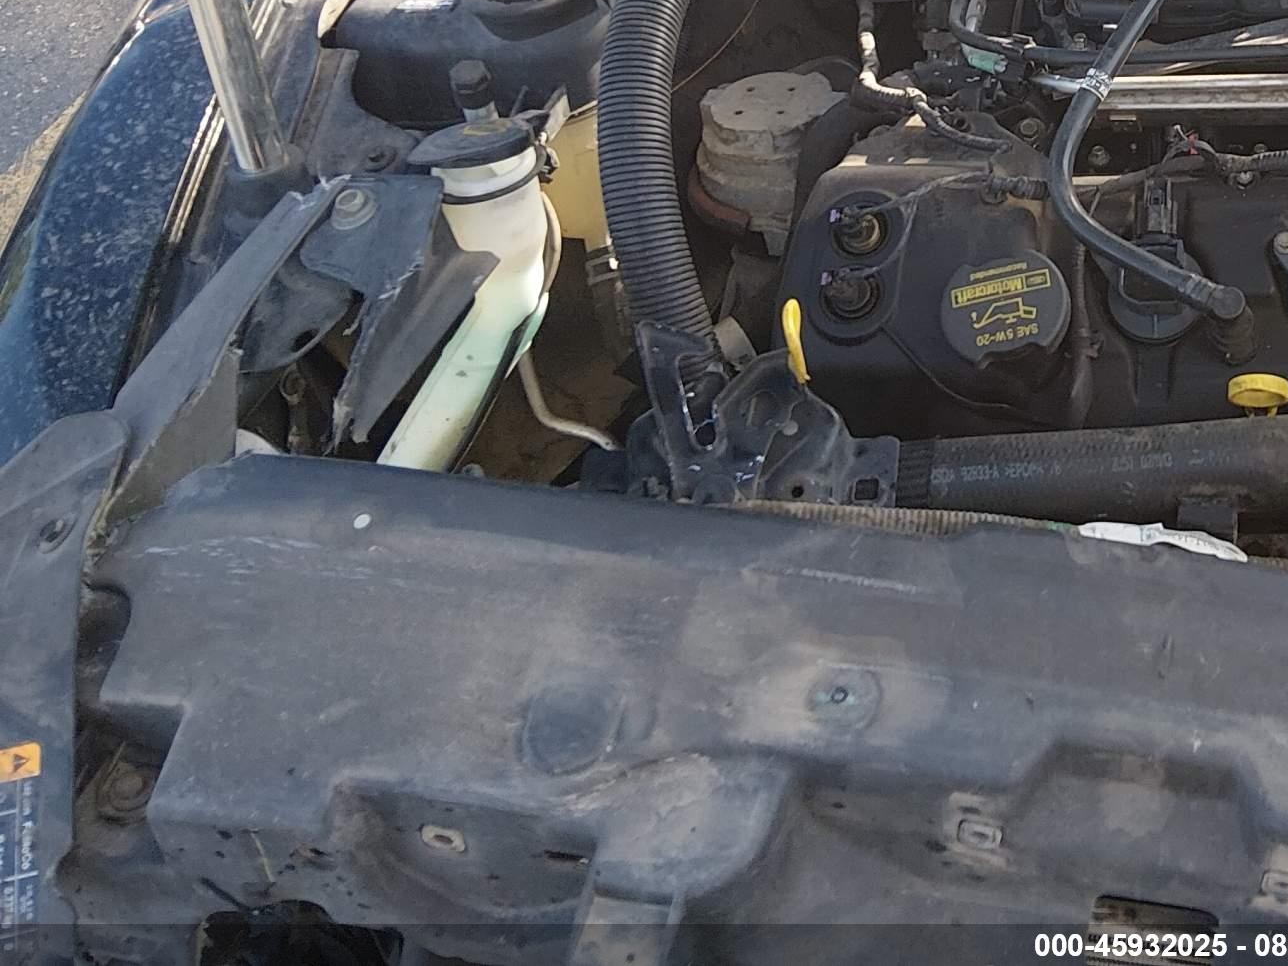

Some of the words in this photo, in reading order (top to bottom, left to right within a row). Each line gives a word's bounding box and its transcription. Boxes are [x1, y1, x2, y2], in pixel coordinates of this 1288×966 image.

[957, 277, 1022, 303] Motorcraft
[976, 328, 1014, 346] 5W-20
[1016, 323, 1039, 337] SAE
